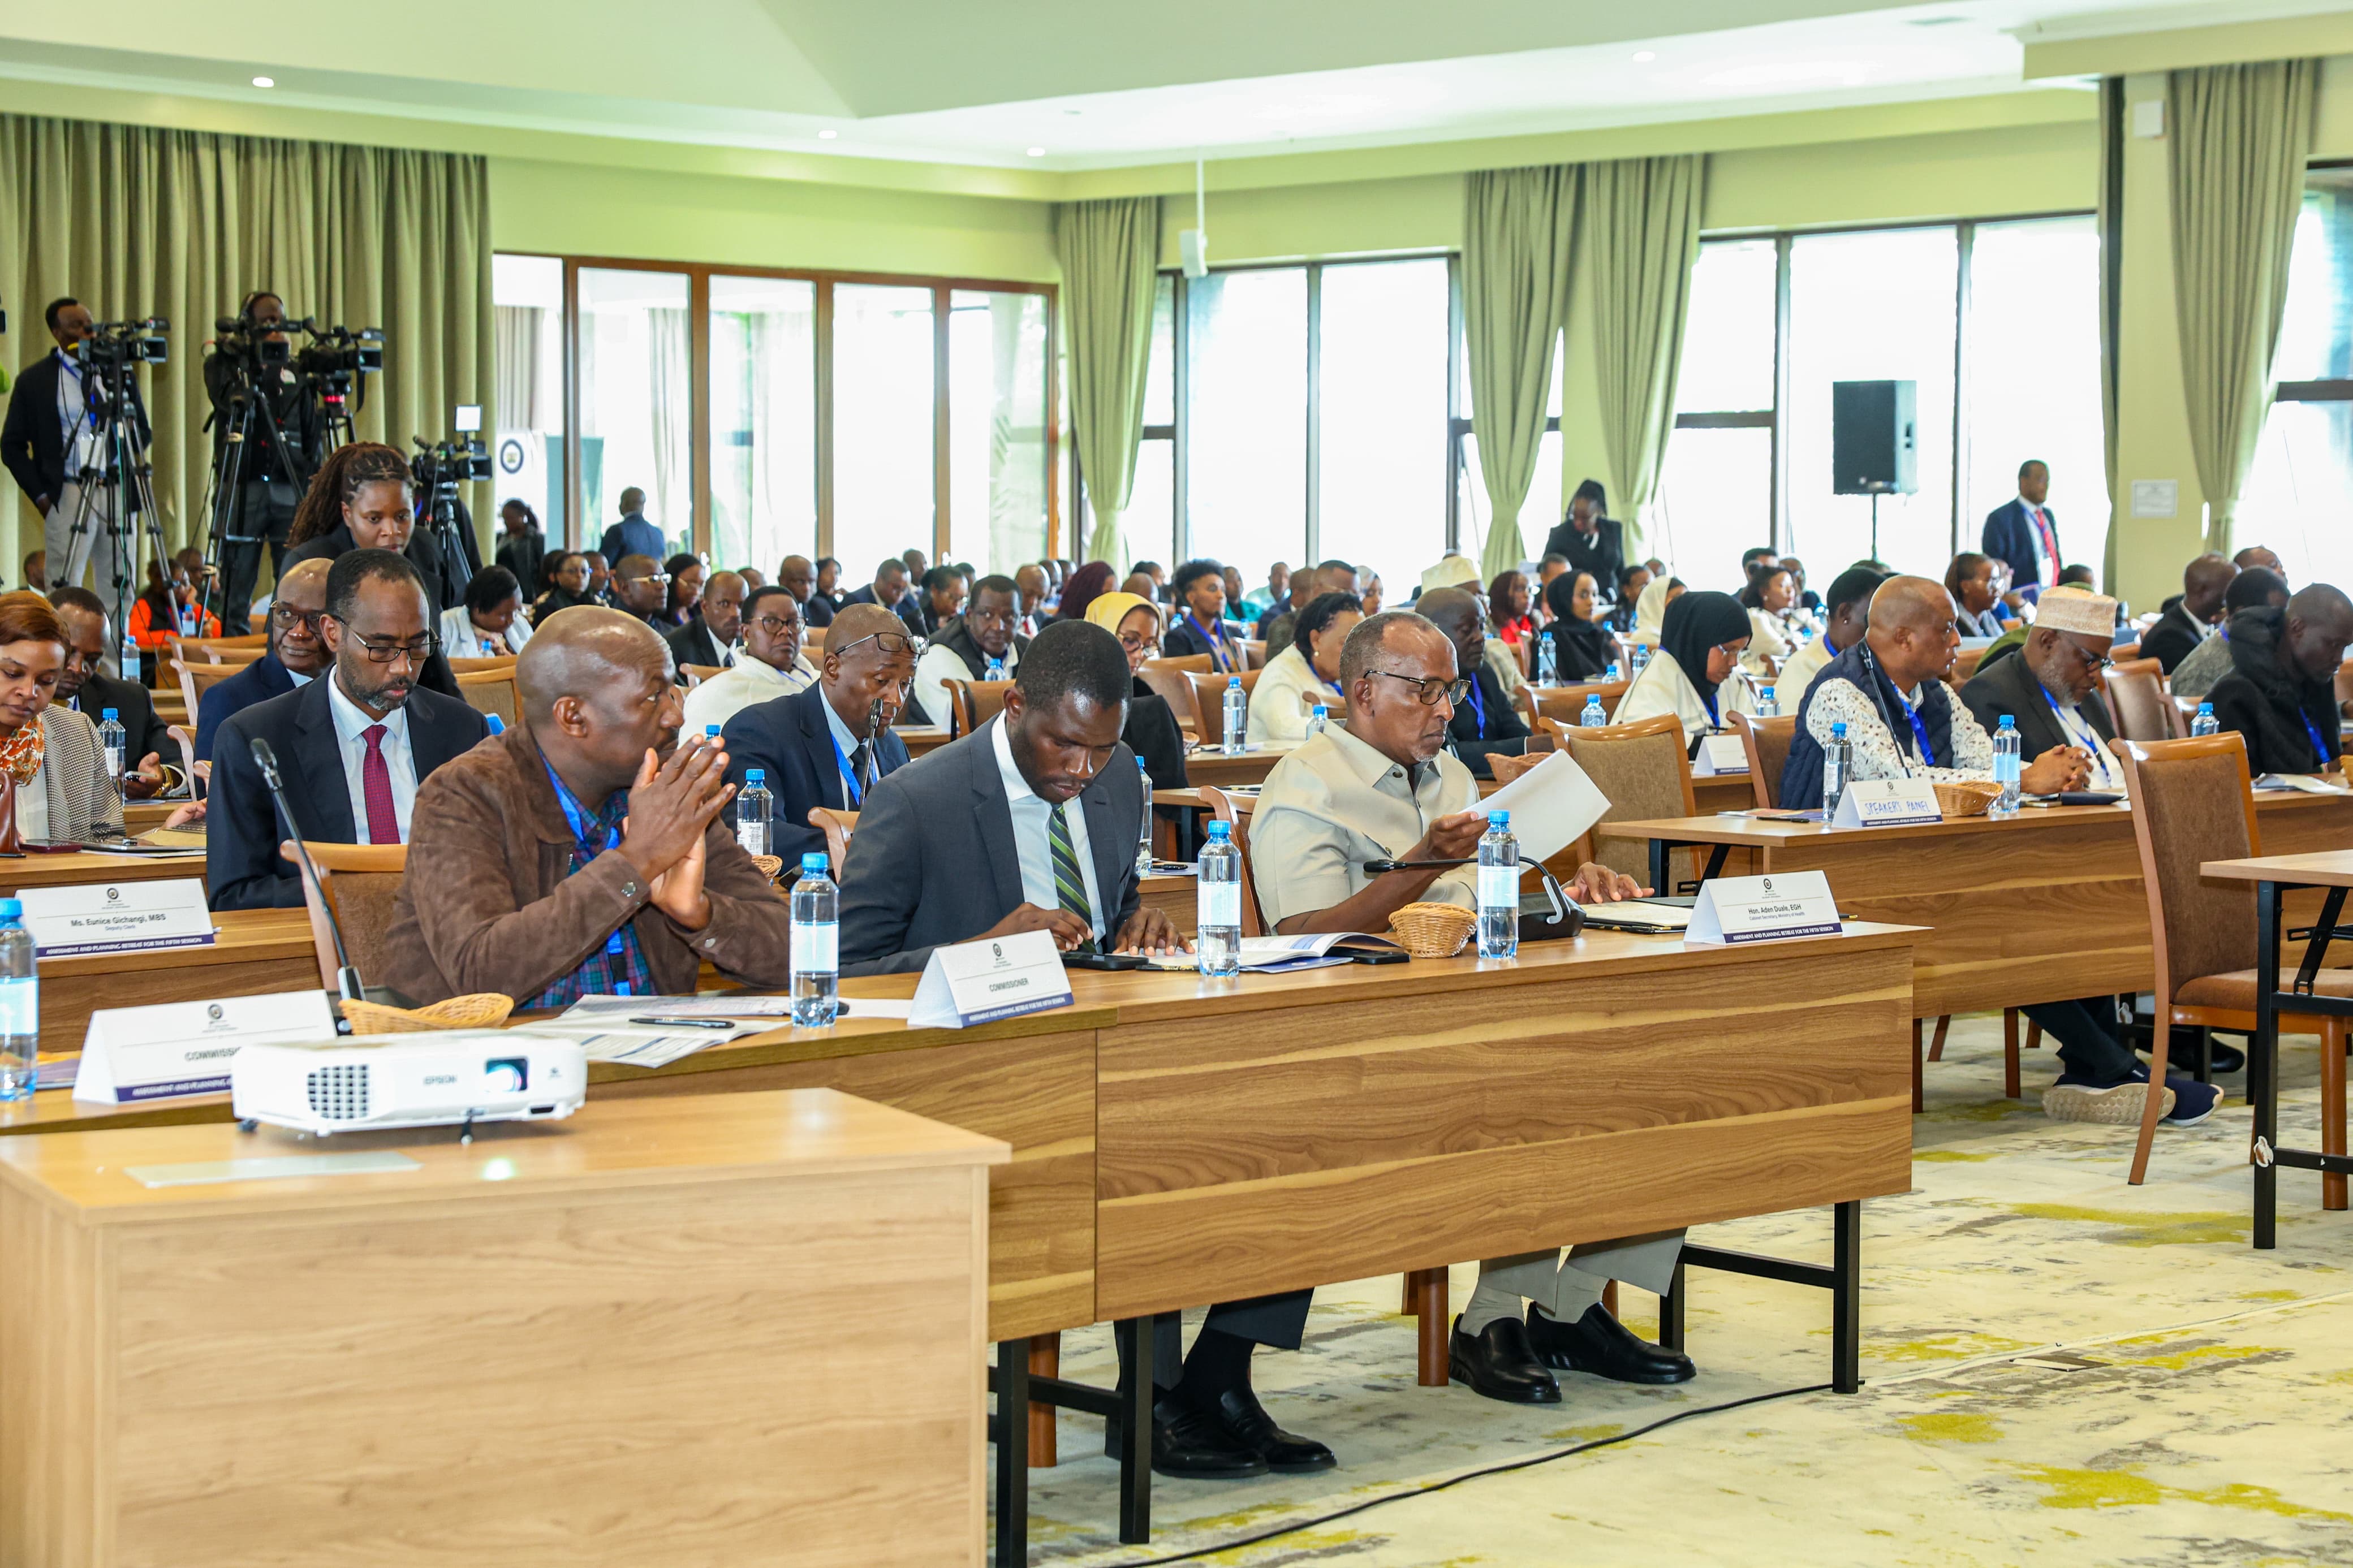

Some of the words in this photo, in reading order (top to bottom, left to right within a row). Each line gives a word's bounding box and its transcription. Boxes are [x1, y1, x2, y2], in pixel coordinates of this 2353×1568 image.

[1906, 801, 1930, 813] PANEL
[86, 917, 111, 926] Eunice
[989, 978, 1029, 992] COMMISSIONER
